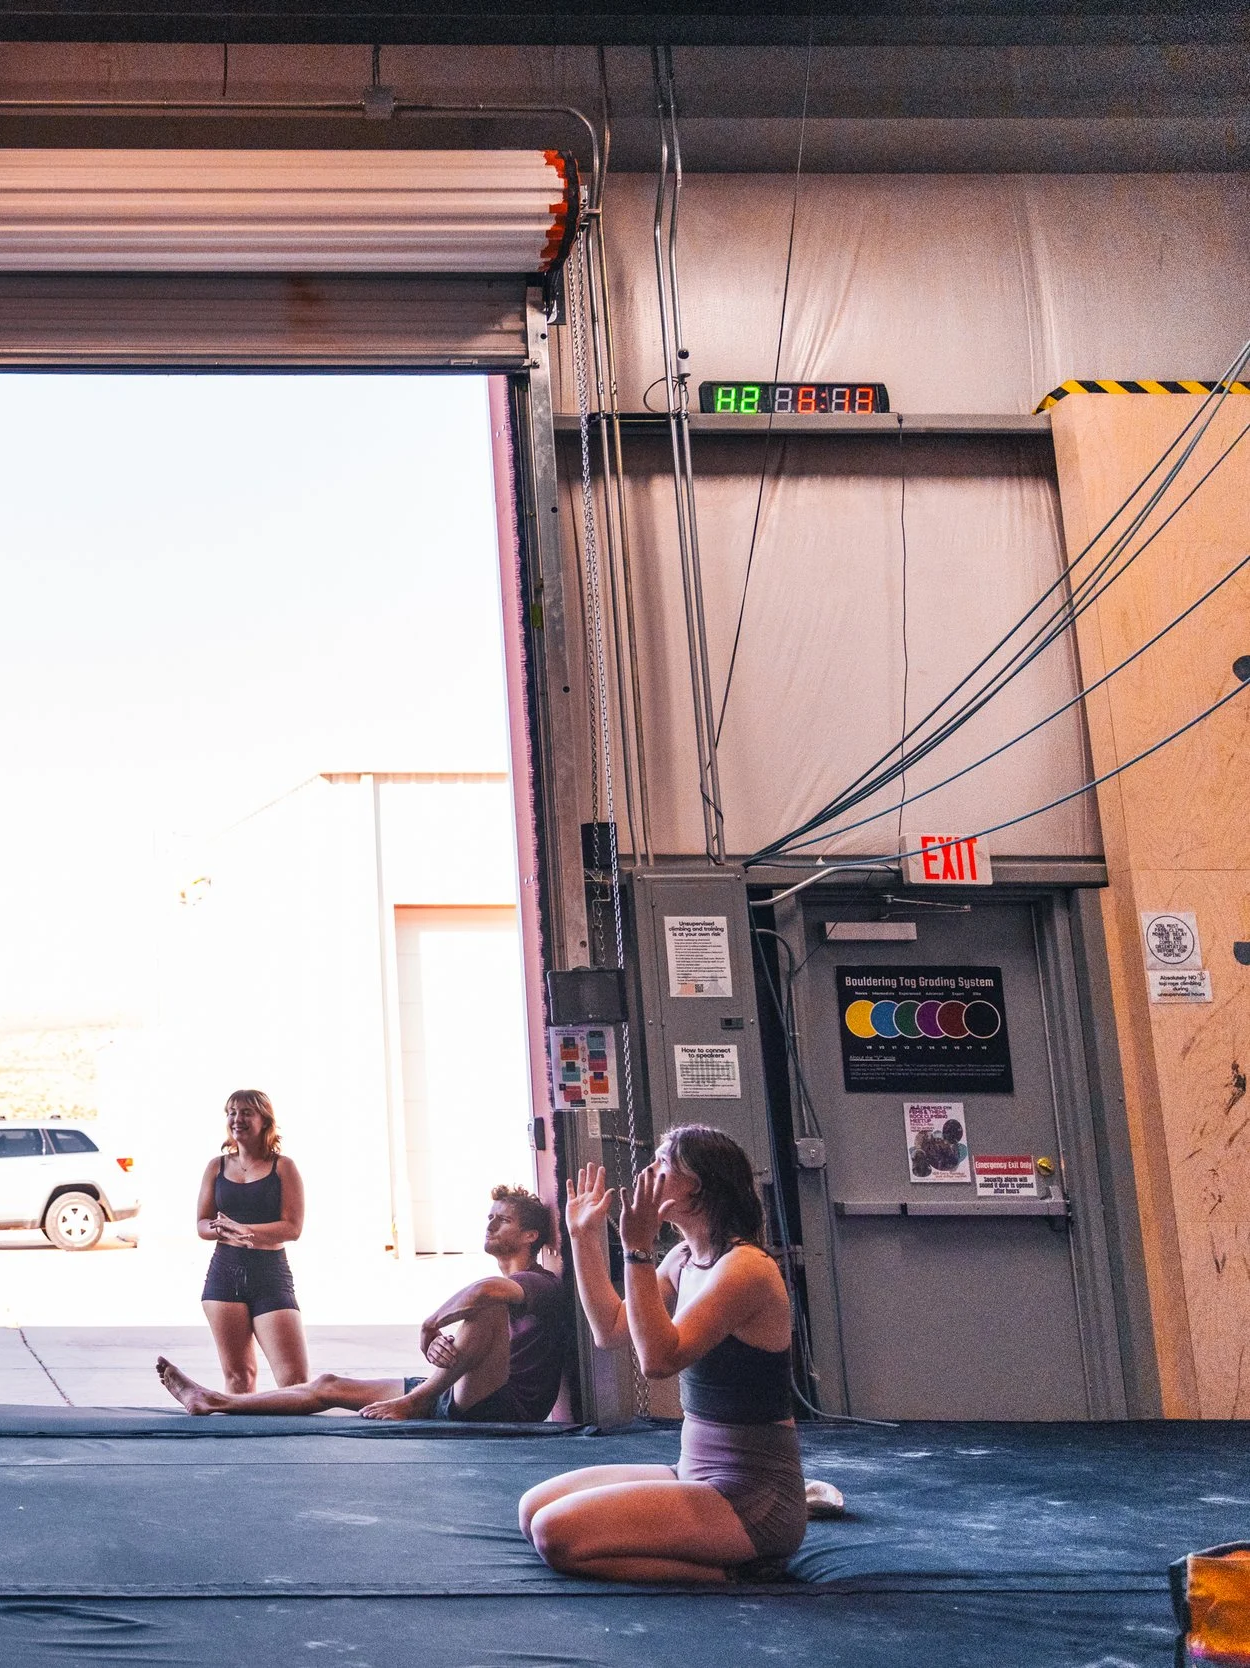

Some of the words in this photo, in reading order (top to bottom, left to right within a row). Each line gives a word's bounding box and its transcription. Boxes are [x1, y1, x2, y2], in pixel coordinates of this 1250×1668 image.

[921, 836, 978, 880] EXIT
[845, 976, 897, 989] Bouldering
[899, 976, 917, 989] Tag
[919, 977, 956, 989] Grading
[958, 977, 994, 989] System
[976, 1161, 1007, 1169] Emergency
